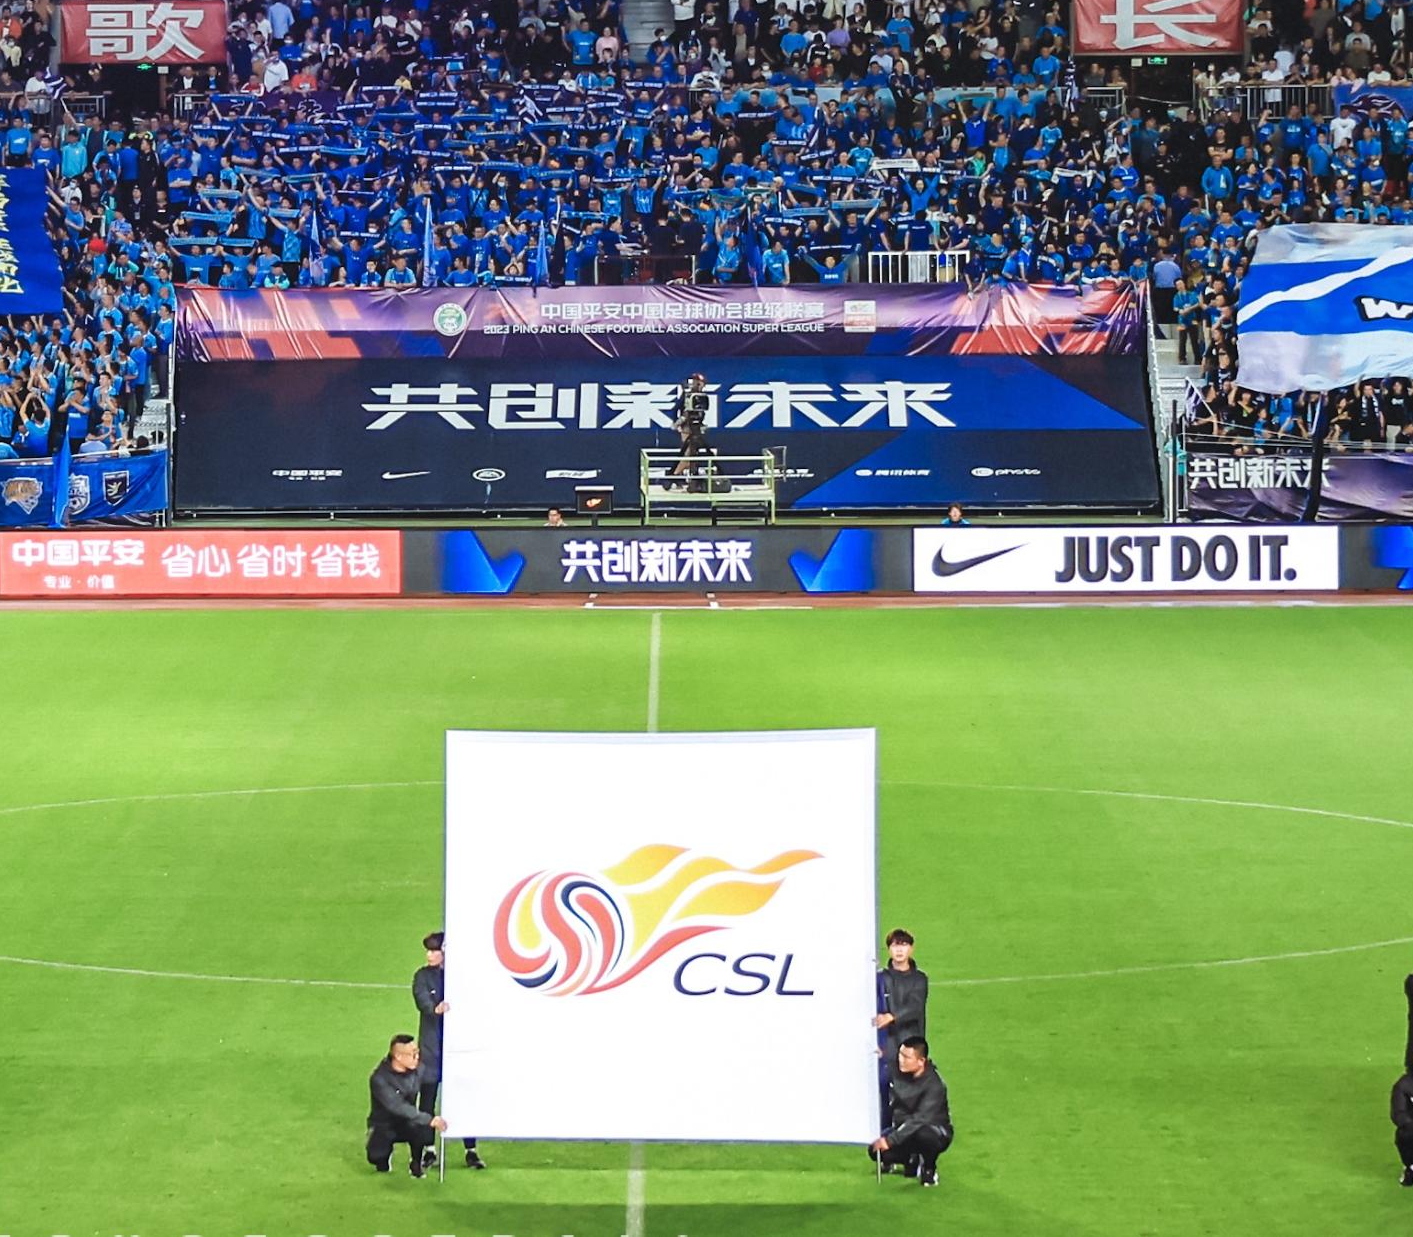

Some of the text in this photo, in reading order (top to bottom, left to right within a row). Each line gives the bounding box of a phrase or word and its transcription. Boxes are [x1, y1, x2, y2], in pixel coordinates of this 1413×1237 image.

[86, 3, 204, 61] 歌
[483, 323, 825, 335] 2023 PING AN CHINESE FOOTBALL ASSOCIATION SUPER LEAGUE
[361, 382, 956, 430] 共创新未来
[1188, 456, 1332, 489] 共创新未来
[11, 539, 145, 566] 中国平安
[161, 543, 380, 578] 省心 省时 省钱
[561, 539, 753, 582] 共创新未来
[1054, 535, 1298, 582] JUST DO IT.
[673, 952, 814, 997] CSL
